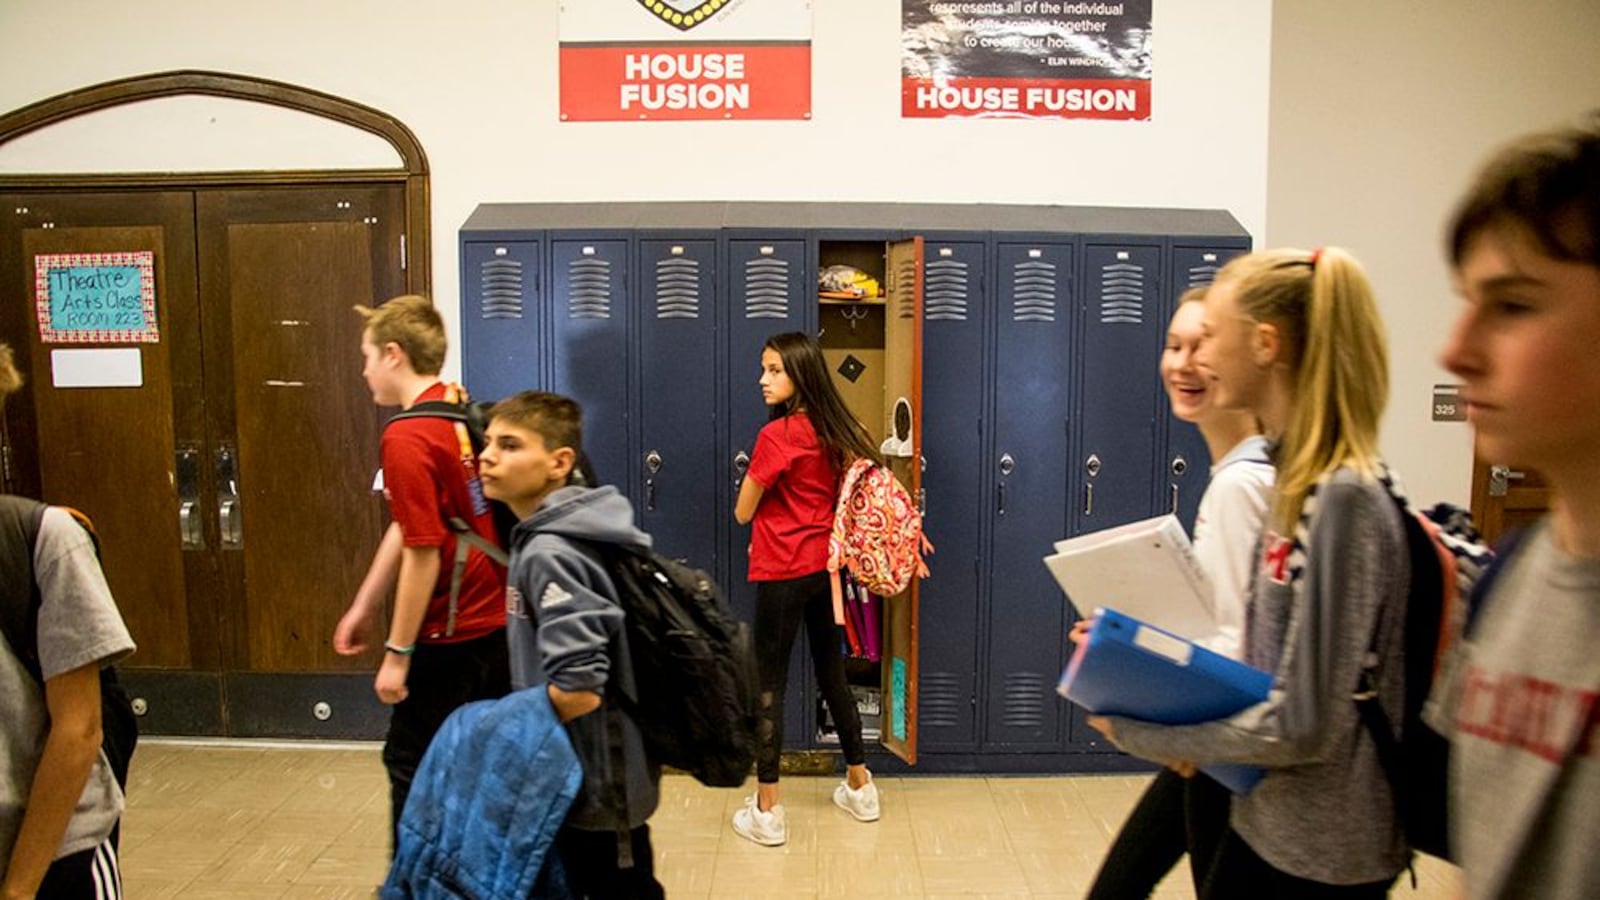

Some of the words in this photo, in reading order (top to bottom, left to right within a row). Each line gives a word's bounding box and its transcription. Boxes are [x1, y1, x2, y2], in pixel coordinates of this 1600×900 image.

[1007, 2, 1021, 14] all
[1024, 2, 1038, 14] of
[1040, 2, 1061, 14] the
[1063, 3, 1123, 15] individual
[1053, 20, 1107, 34] together
[964, 35, 977, 47] to
[1023, 38, 1045, 48] our
[625, 54, 745, 80] HOUSE
[1048, 57, 1067, 66] ELIN
[620, 83, 749, 110] FUSION
[916, 87, 1019, 110] HOUSE
[1027, 88, 1136, 111] FUSION
[49, 267, 129, 291] Theatre
[61, 294, 103, 312] Arts
[106, 290, 142, 309] Class
[66, 312, 109, 326] ROOM
[115, 312, 141, 325] 223
[1435, 404, 1456, 416] 325
